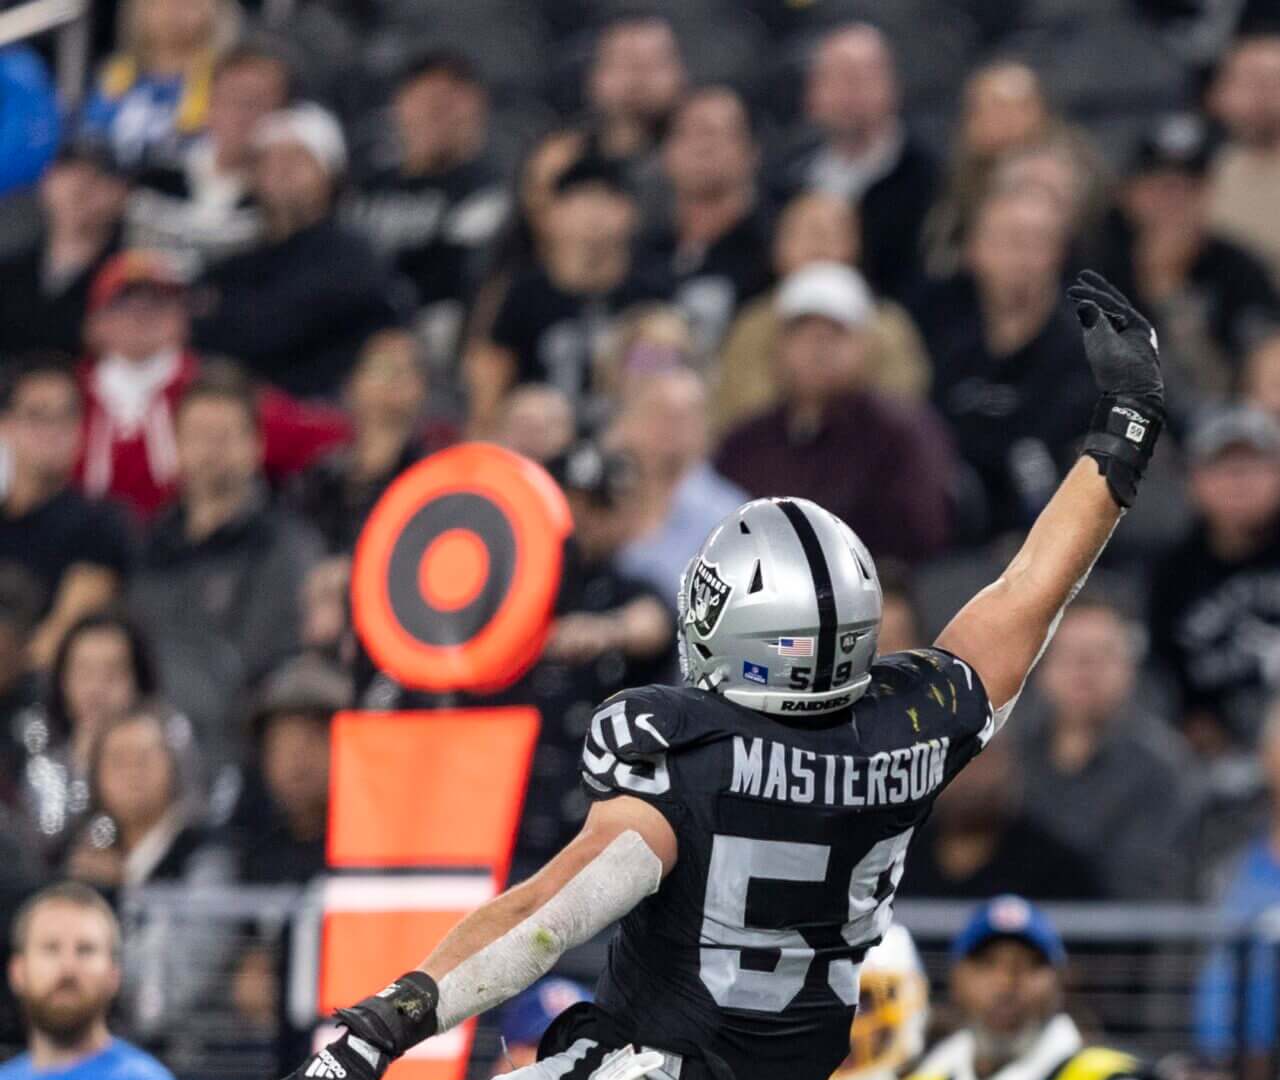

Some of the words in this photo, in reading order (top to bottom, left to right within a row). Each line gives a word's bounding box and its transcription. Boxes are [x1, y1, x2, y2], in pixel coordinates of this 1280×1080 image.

[780, 694, 851, 711] RAIDERS
[729, 735, 950, 806] MASTERSON
[699, 826, 915, 1013] 59
